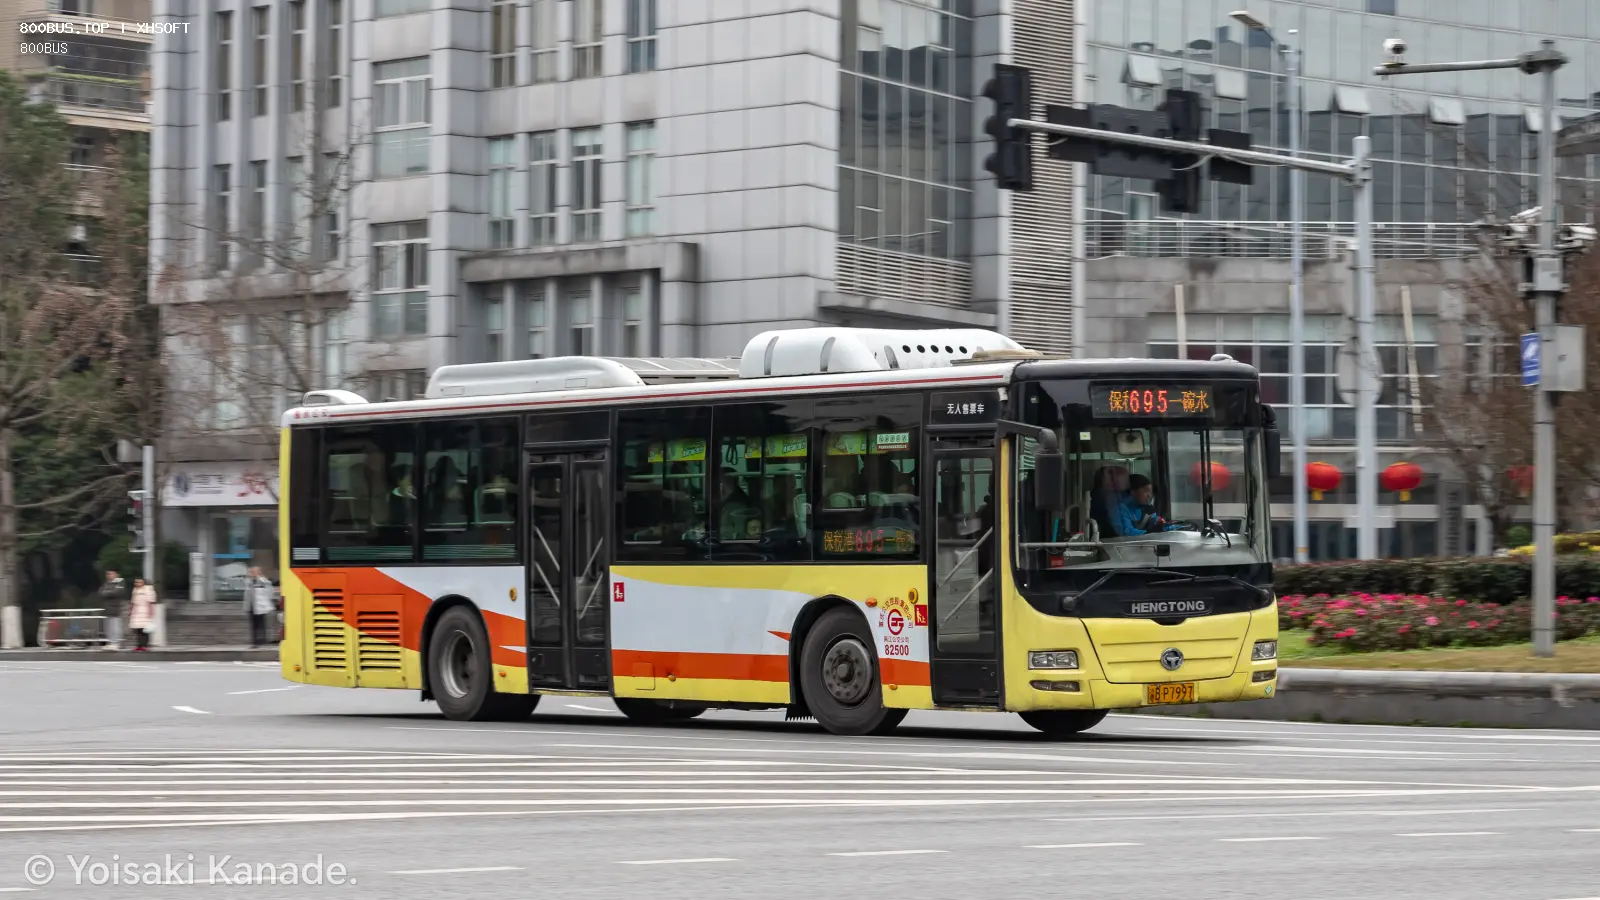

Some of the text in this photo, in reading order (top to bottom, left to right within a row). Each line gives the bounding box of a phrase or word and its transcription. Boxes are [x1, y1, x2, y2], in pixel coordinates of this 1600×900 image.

[947, 401, 985, 415] 无人售票车
[1131, 600, 1205, 614] HENGTONG
[884, 644, 910, 656] 82500
